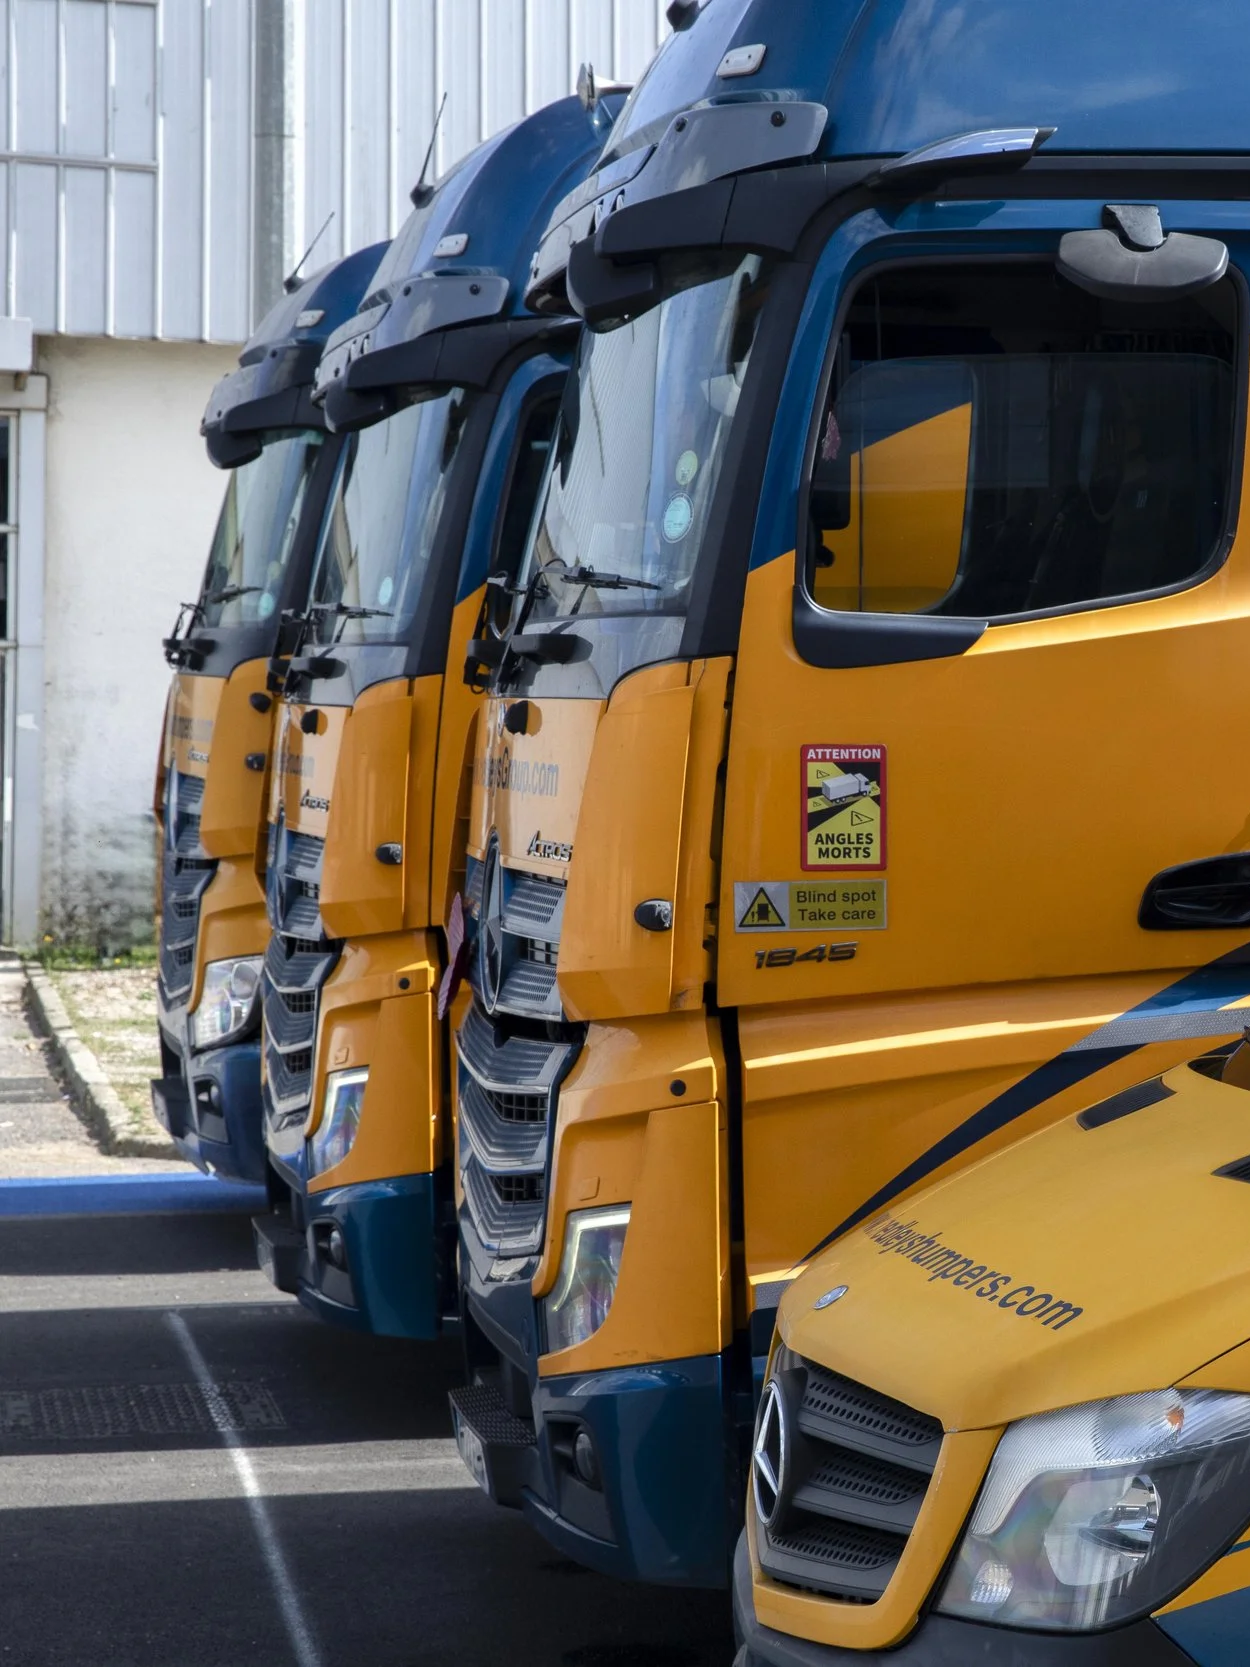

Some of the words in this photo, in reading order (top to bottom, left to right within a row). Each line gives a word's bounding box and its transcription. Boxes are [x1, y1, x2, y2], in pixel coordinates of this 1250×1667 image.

[807, 748, 881, 759] ATTENTION
[814, 833, 873, 845] ANGLES
[818, 847, 871, 858] MORTS
[796, 890, 837, 903] Blind
[842, 889, 877, 904] spot
[798, 909, 836, 921] Take
[842, 909, 876, 920] care
[755, 941, 858, 969] 1845
